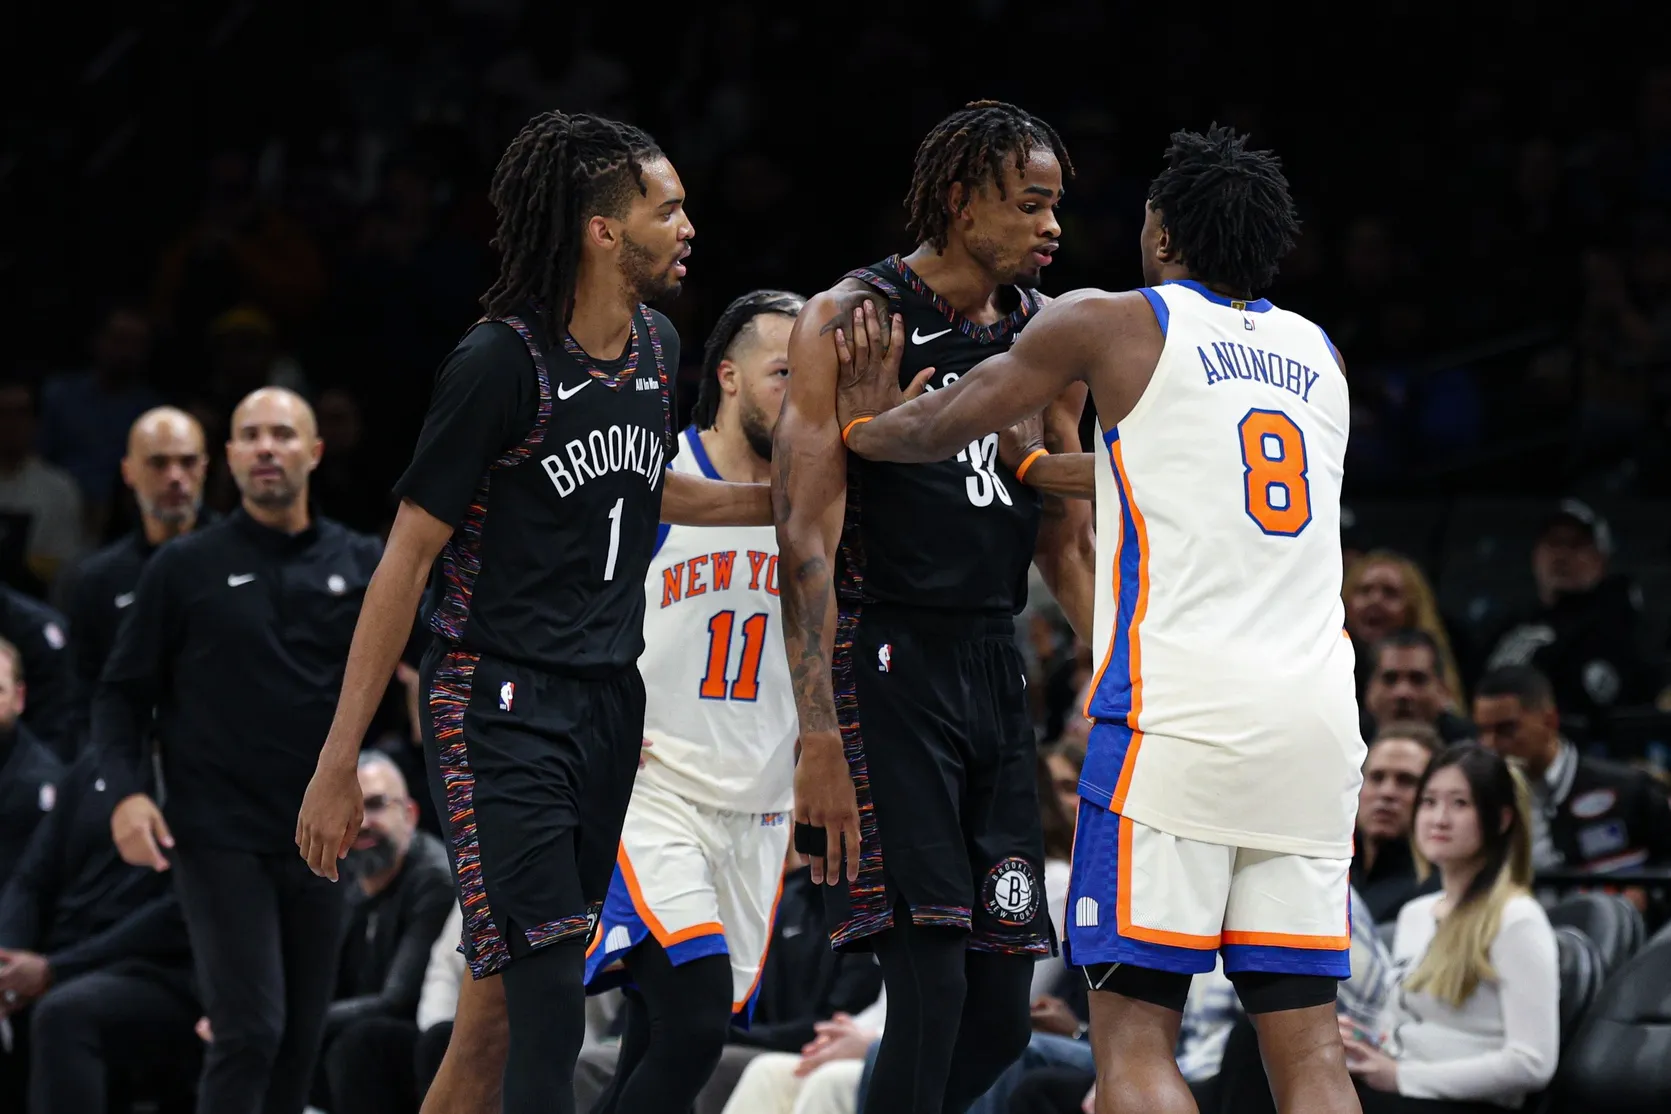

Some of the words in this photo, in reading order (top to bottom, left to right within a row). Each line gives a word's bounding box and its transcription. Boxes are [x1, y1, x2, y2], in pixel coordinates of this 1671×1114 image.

[1197, 341, 1320, 403] ANUNOBY
[540, 424, 665, 498] BROOKLYN
[1237, 407, 1313, 538] 8
[603, 497, 624, 581] 1
[660, 550, 737, 609] NEW
[747, 550, 780, 597] YO
[699, 610, 769, 703] 11
[992, 862, 1033, 885] BROOKLYN
[989, 900, 1007, 918] NEW
[1014, 905, 1033, 920] YORK
